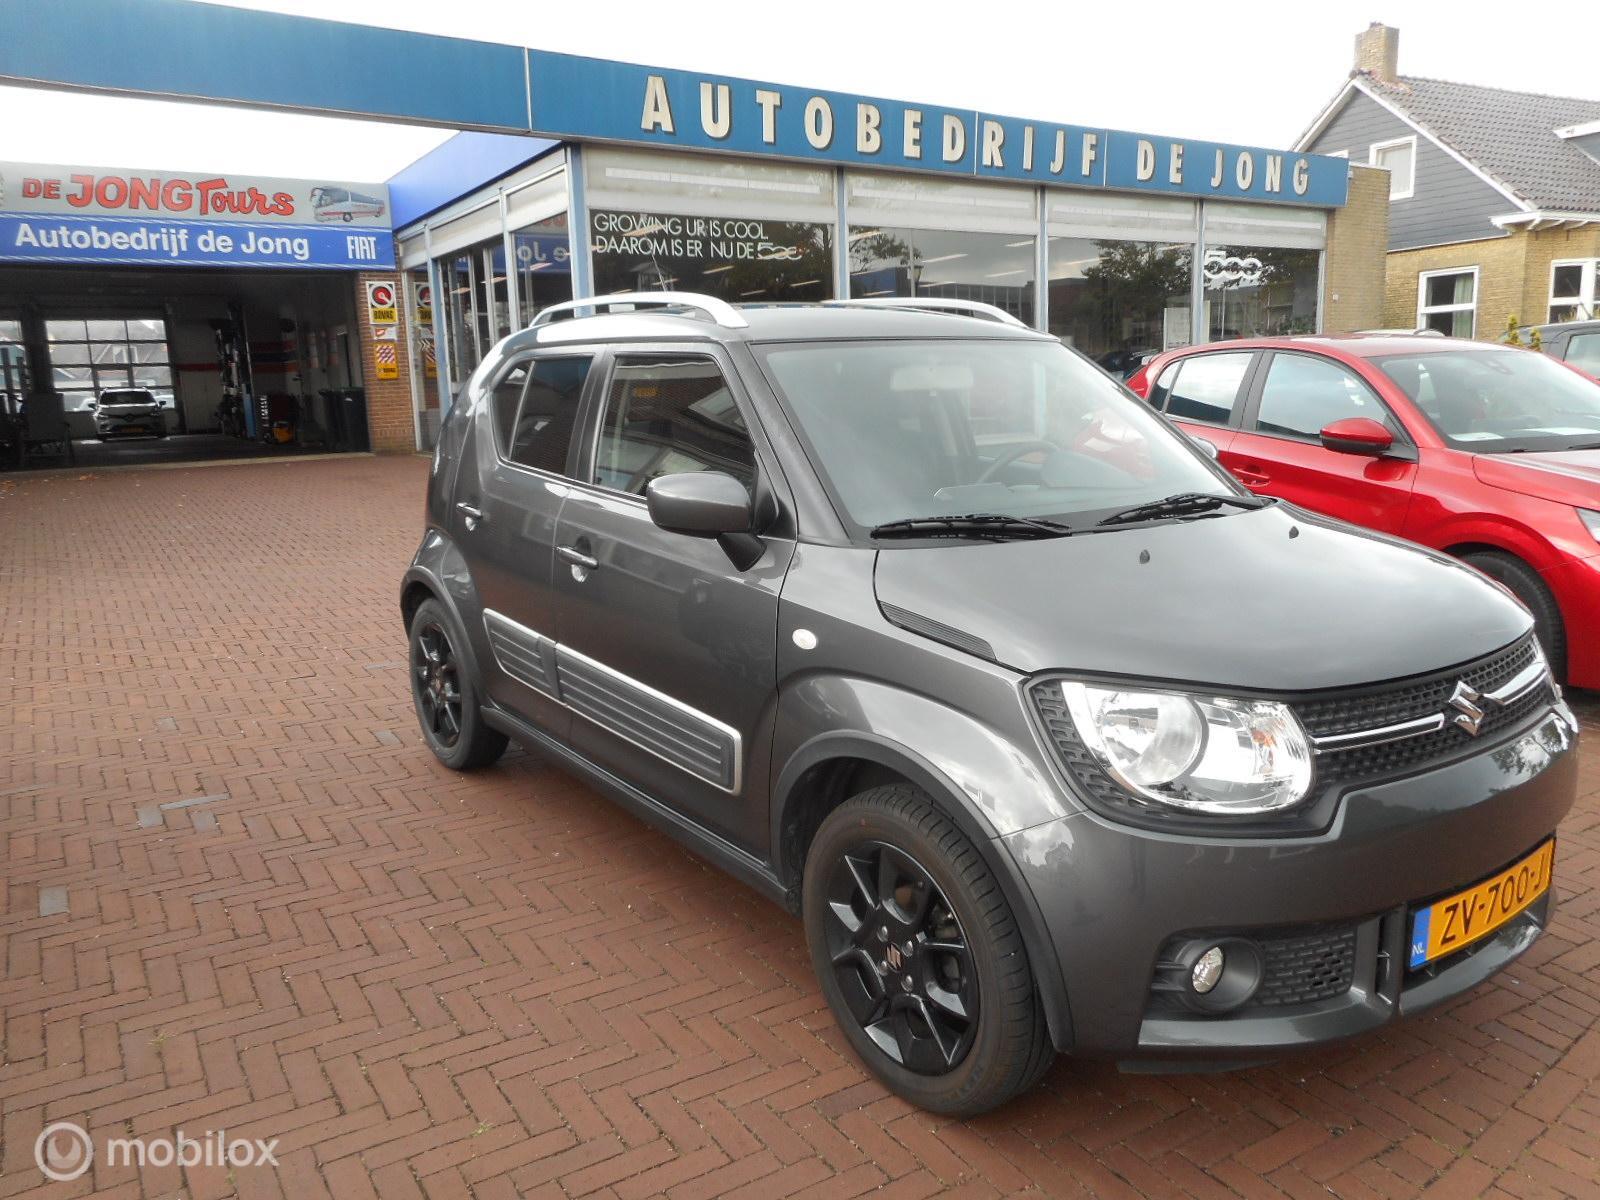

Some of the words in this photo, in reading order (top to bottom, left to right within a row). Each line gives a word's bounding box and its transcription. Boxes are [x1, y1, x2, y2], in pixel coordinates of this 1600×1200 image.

[641, 75, 1098, 177] AUTOBEDRIJF
[1136, 139, 1184, 184] DE
[1210, 149, 1310, 196] JONG
[22, 177, 61, 199] DE
[66, 174, 193, 211] JONG
[195, 178, 295, 216] Tours
[15, 223, 189, 257] Autobedrijf
[198, 229, 234, 253] de
[241, 232, 310, 260] Jong
[594, 213, 682, 235] GROWING
[710, 218, 721, 238] IS
[724, 220, 768, 240] COOL
[346, 235, 377, 260] FIAT
[596, 236, 671, 256] DAAROM
[671, 238, 683, 256] IS
[687, 240, 704, 258] ER
[710, 241, 734, 259] NU
[736, 241, 754, 259] DE
[1203, 250, 1263, 280] 500
[1440, 853, 1544, 945] ZV-700-J
[1411, 942, 1425, 955] NL
